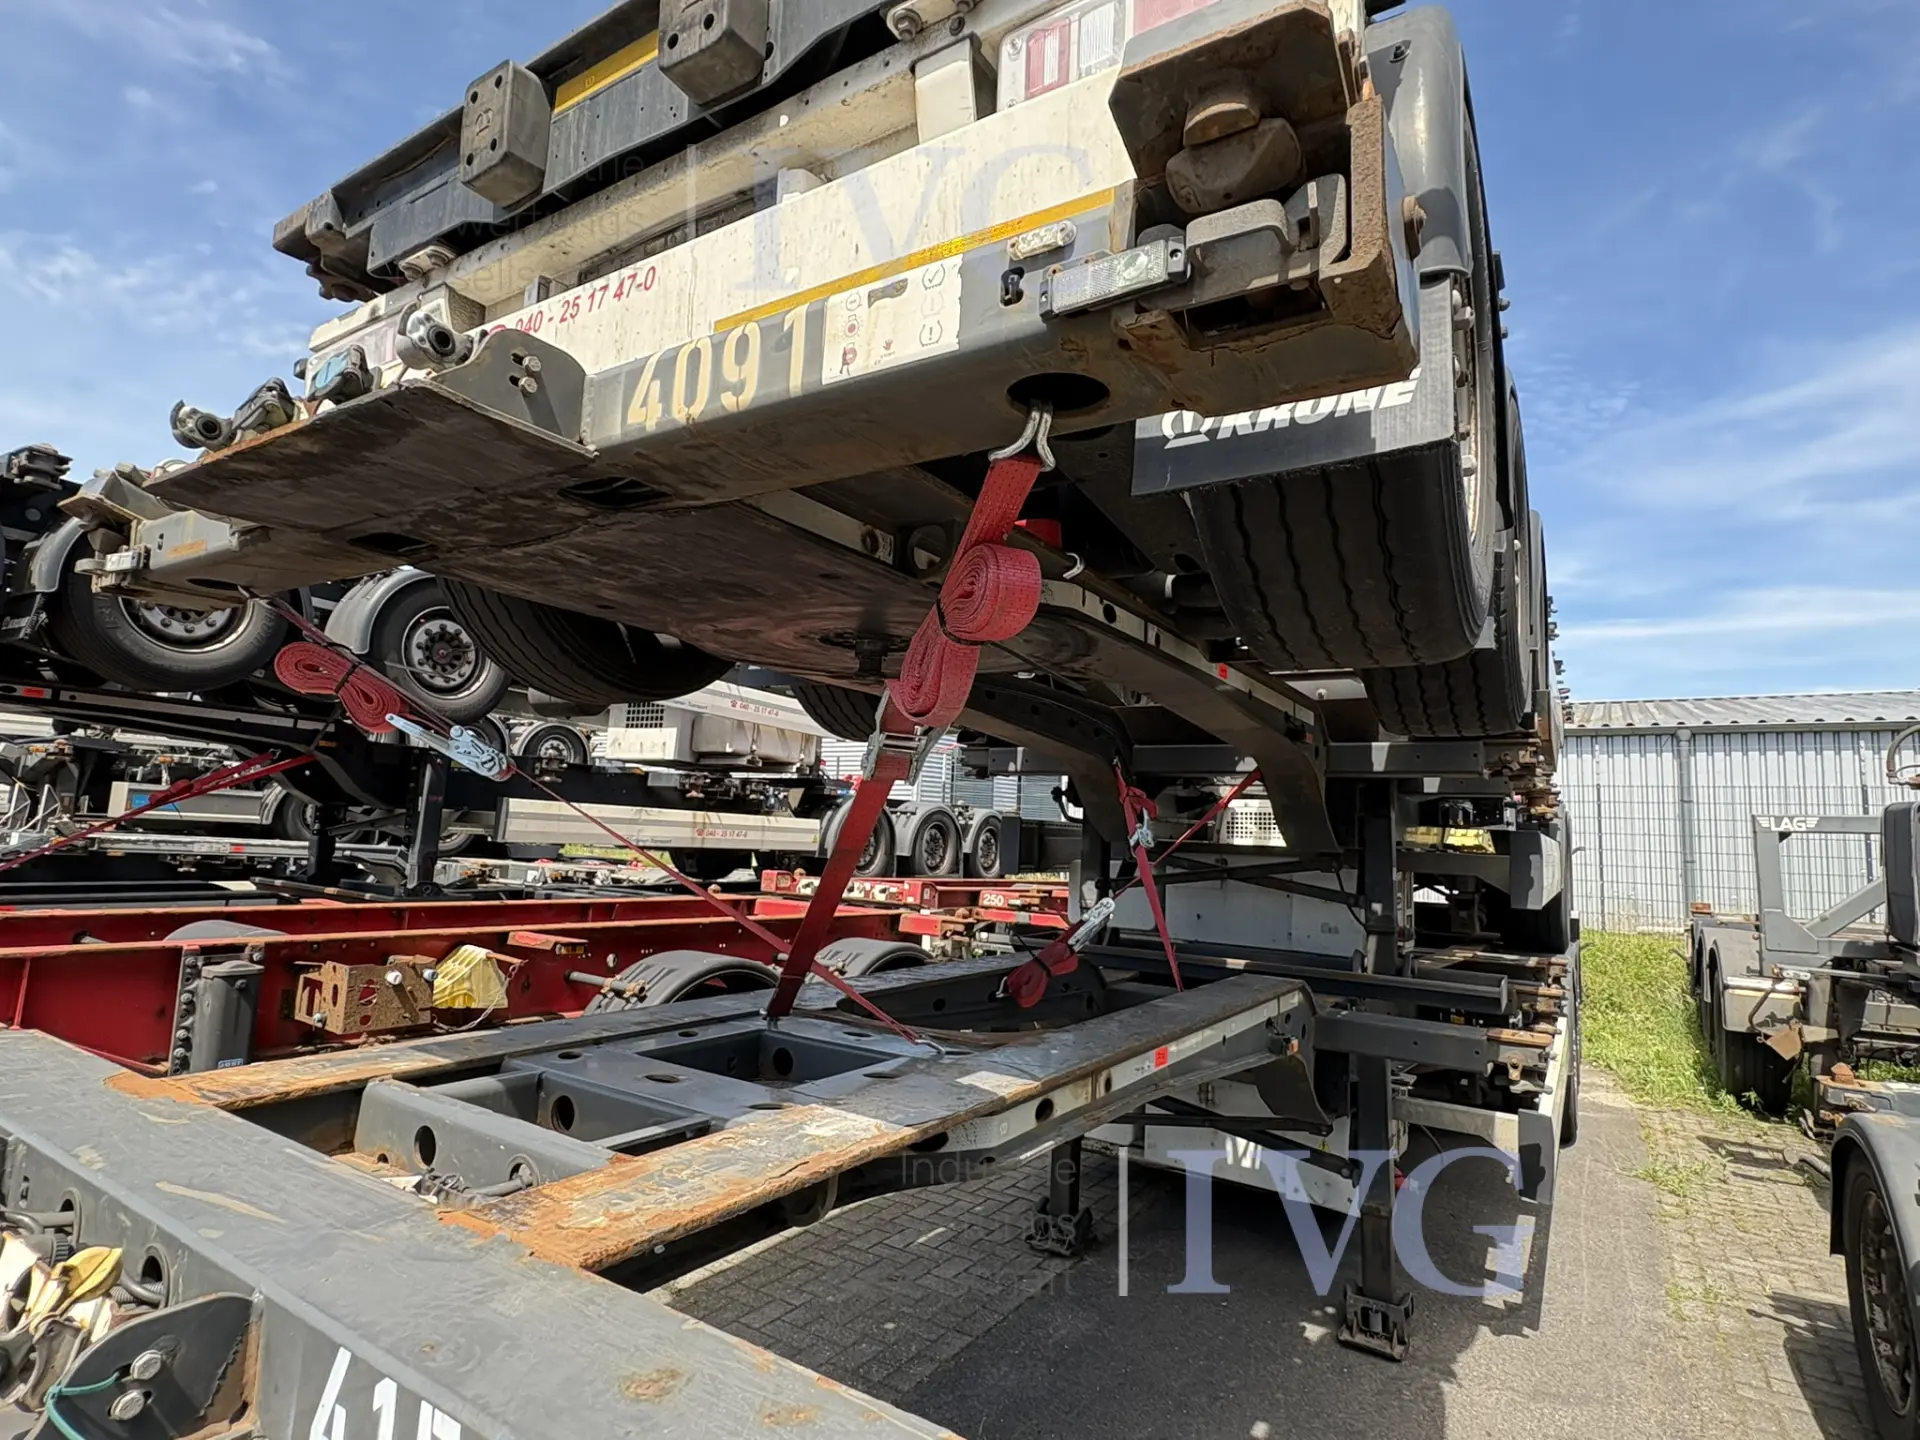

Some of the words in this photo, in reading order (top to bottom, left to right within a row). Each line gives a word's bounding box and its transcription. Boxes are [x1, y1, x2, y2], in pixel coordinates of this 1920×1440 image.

[559, 296, 581, 324] 25
[587, 286, 609, 313] 17
[613, 266, 656, 301] 47-0
[627, 301, 810, 432] 4091
[1769, 816, 1807, 831] LAG
[983, 893, 1004, 906] 250
